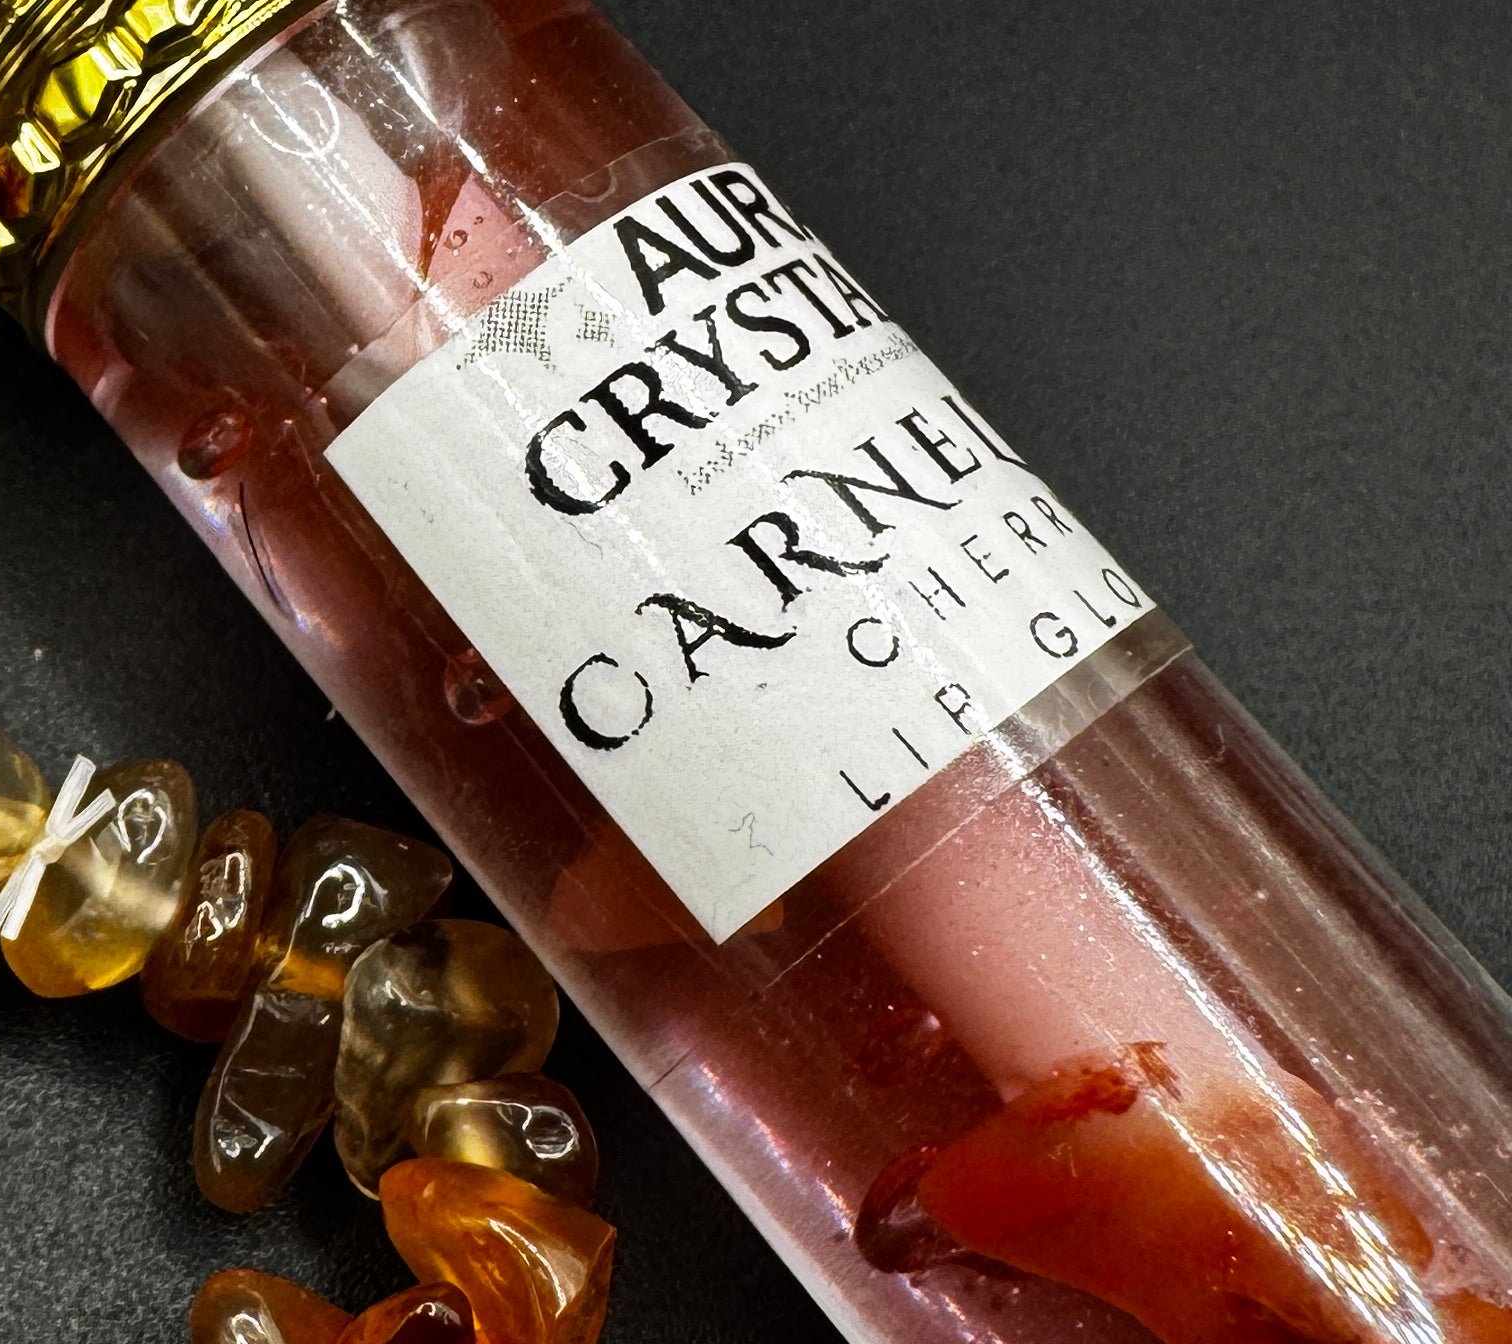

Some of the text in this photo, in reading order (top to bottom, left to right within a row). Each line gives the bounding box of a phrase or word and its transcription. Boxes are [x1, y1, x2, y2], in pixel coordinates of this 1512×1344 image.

[613, 170, 814, 317] AUR
[846, 495, 1074, 669] CHERR
[838, 567, 1142, 812] LIP GLO
